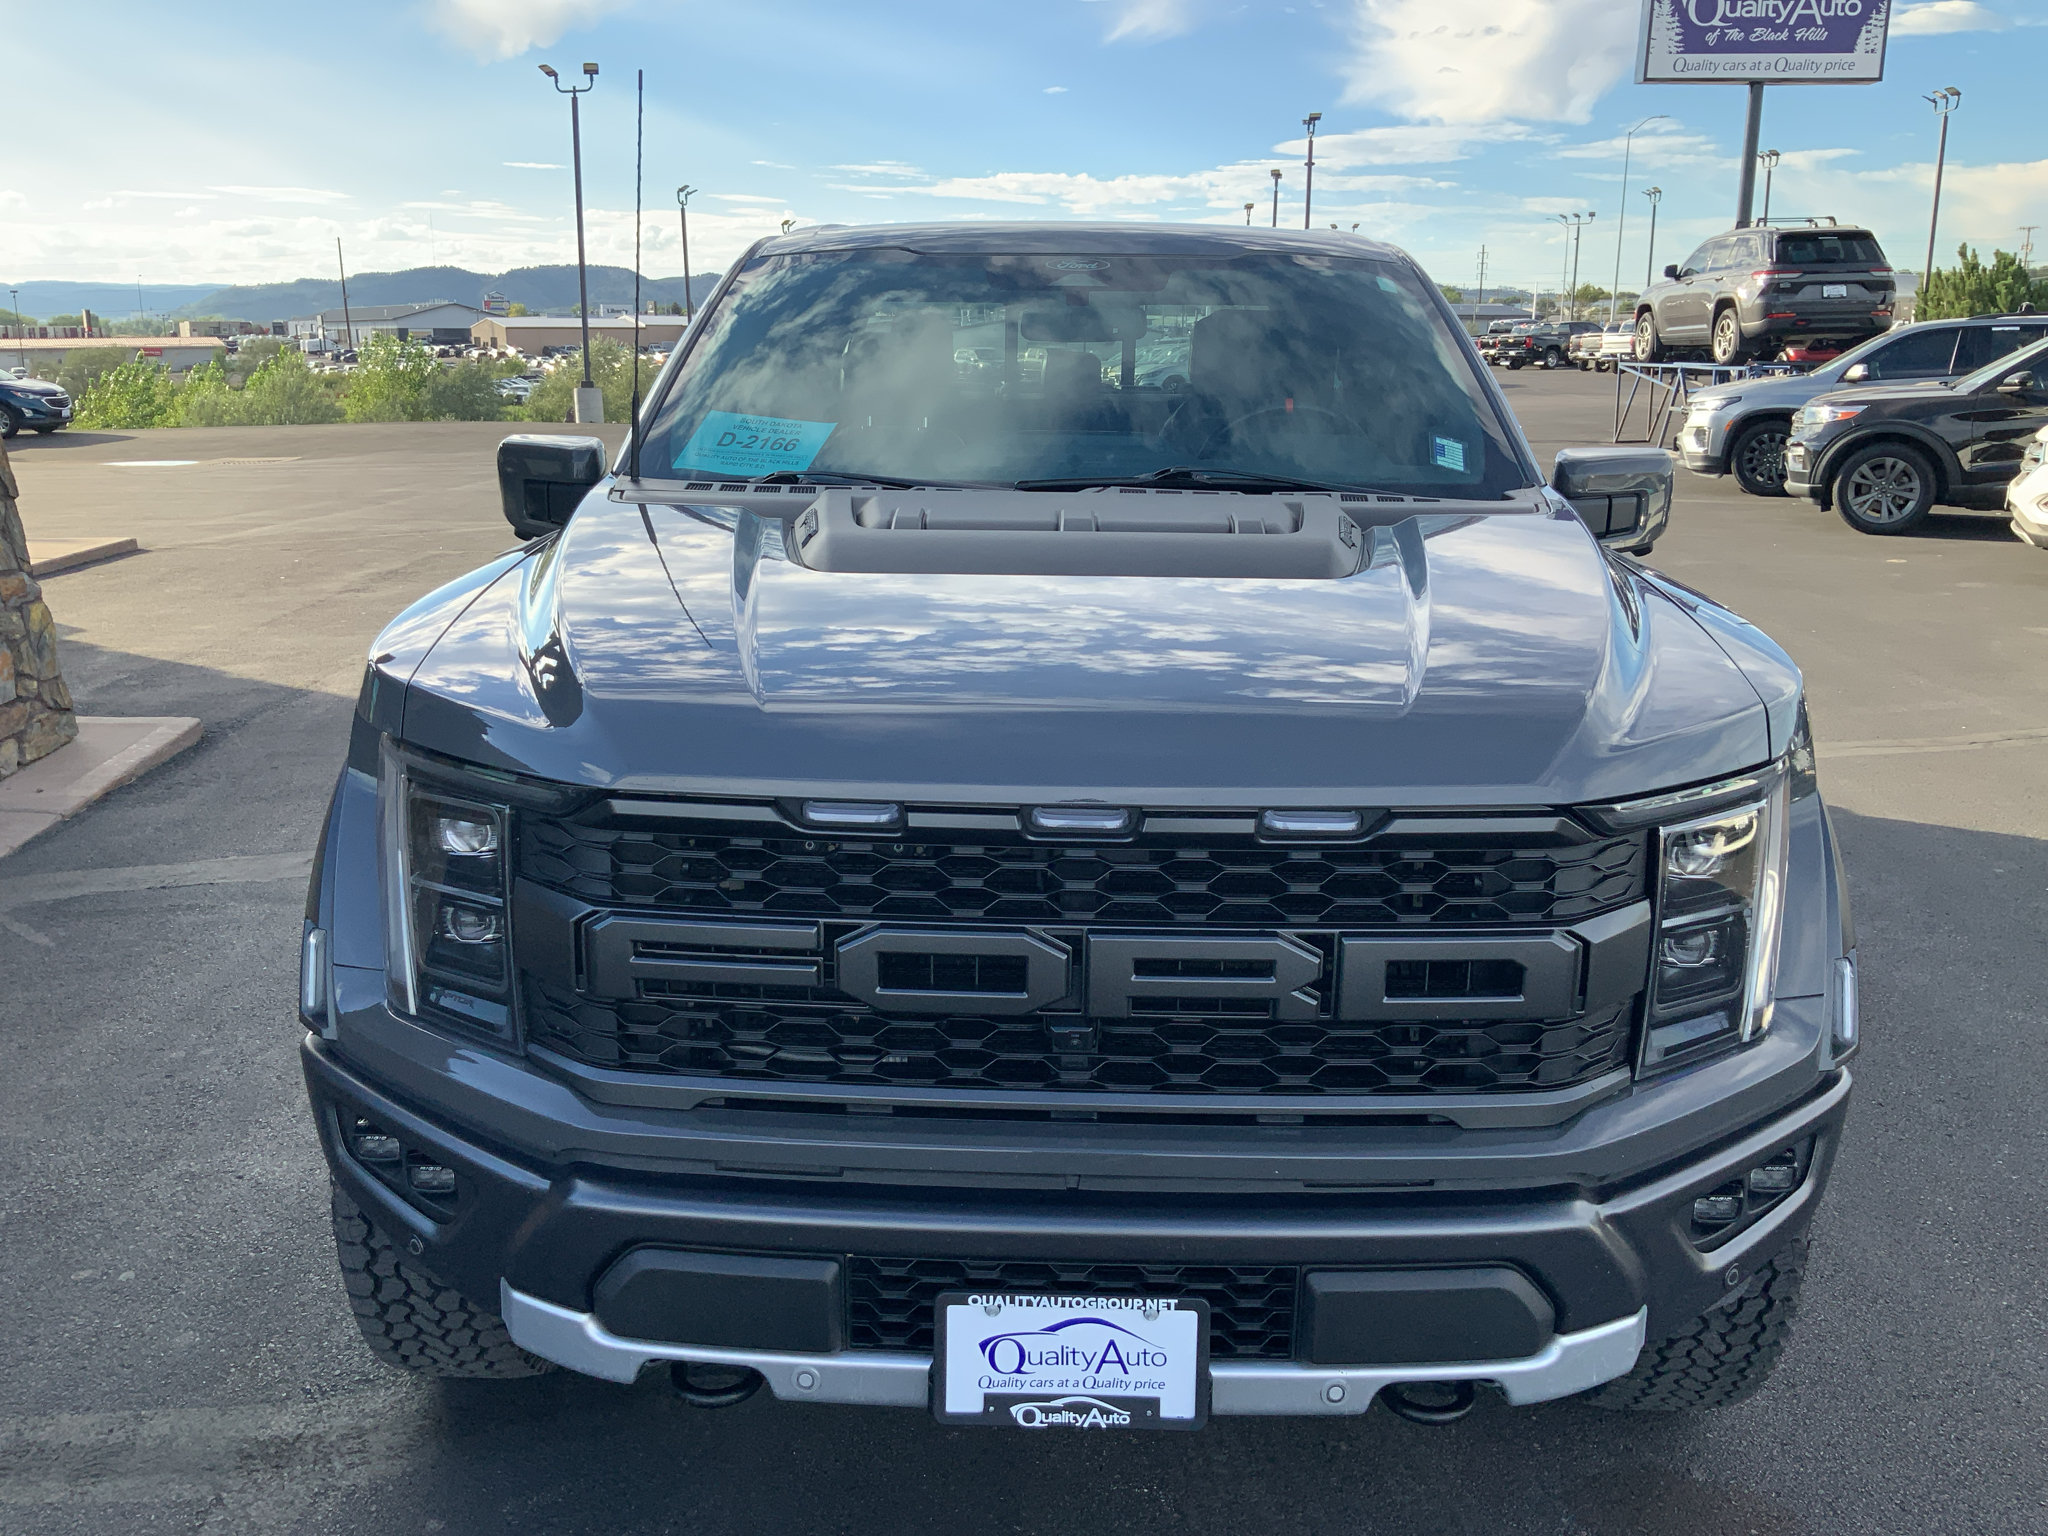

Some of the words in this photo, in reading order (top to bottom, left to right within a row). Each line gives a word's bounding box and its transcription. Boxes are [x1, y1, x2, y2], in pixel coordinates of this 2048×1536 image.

[1705, 28, 1720, 46] of
[1724, 28, 1745, 41] The
[1749, 27, 1789, 41] Black
[1794, 27, 1828, 41] Hills
[1673, 57, 1720, 74] Quality
[1722, 61, 1746, 71] cars
[1749, 61, 1761, 71] at
[1764, 61, 1771, 71] a
[1774, 57, 1822, 74] Quality
[1824, 59, 1855, 73] price
[733, 424, 767, 433] VEHICLE
[768, 428, 801, 436] DEALER
[740, 418, 769, 426] SOUTH
[716, 432, 800, 452] D-2166
[591, 914, 1579, 1020] FORD
[967, 1294, 1179, 1311] QUALITYAUTOGROUP.NET
[977, 1375, 1027, 1391] Quality
[1029, 1379, 1055, 1389] cars
[1057, 1379, 1070, 1389] at
[1072, 1380, 1080, 1389] a
[1082, 1375, 1131, 1391] Quality
[1134, 1379, 1166, 1392] price
